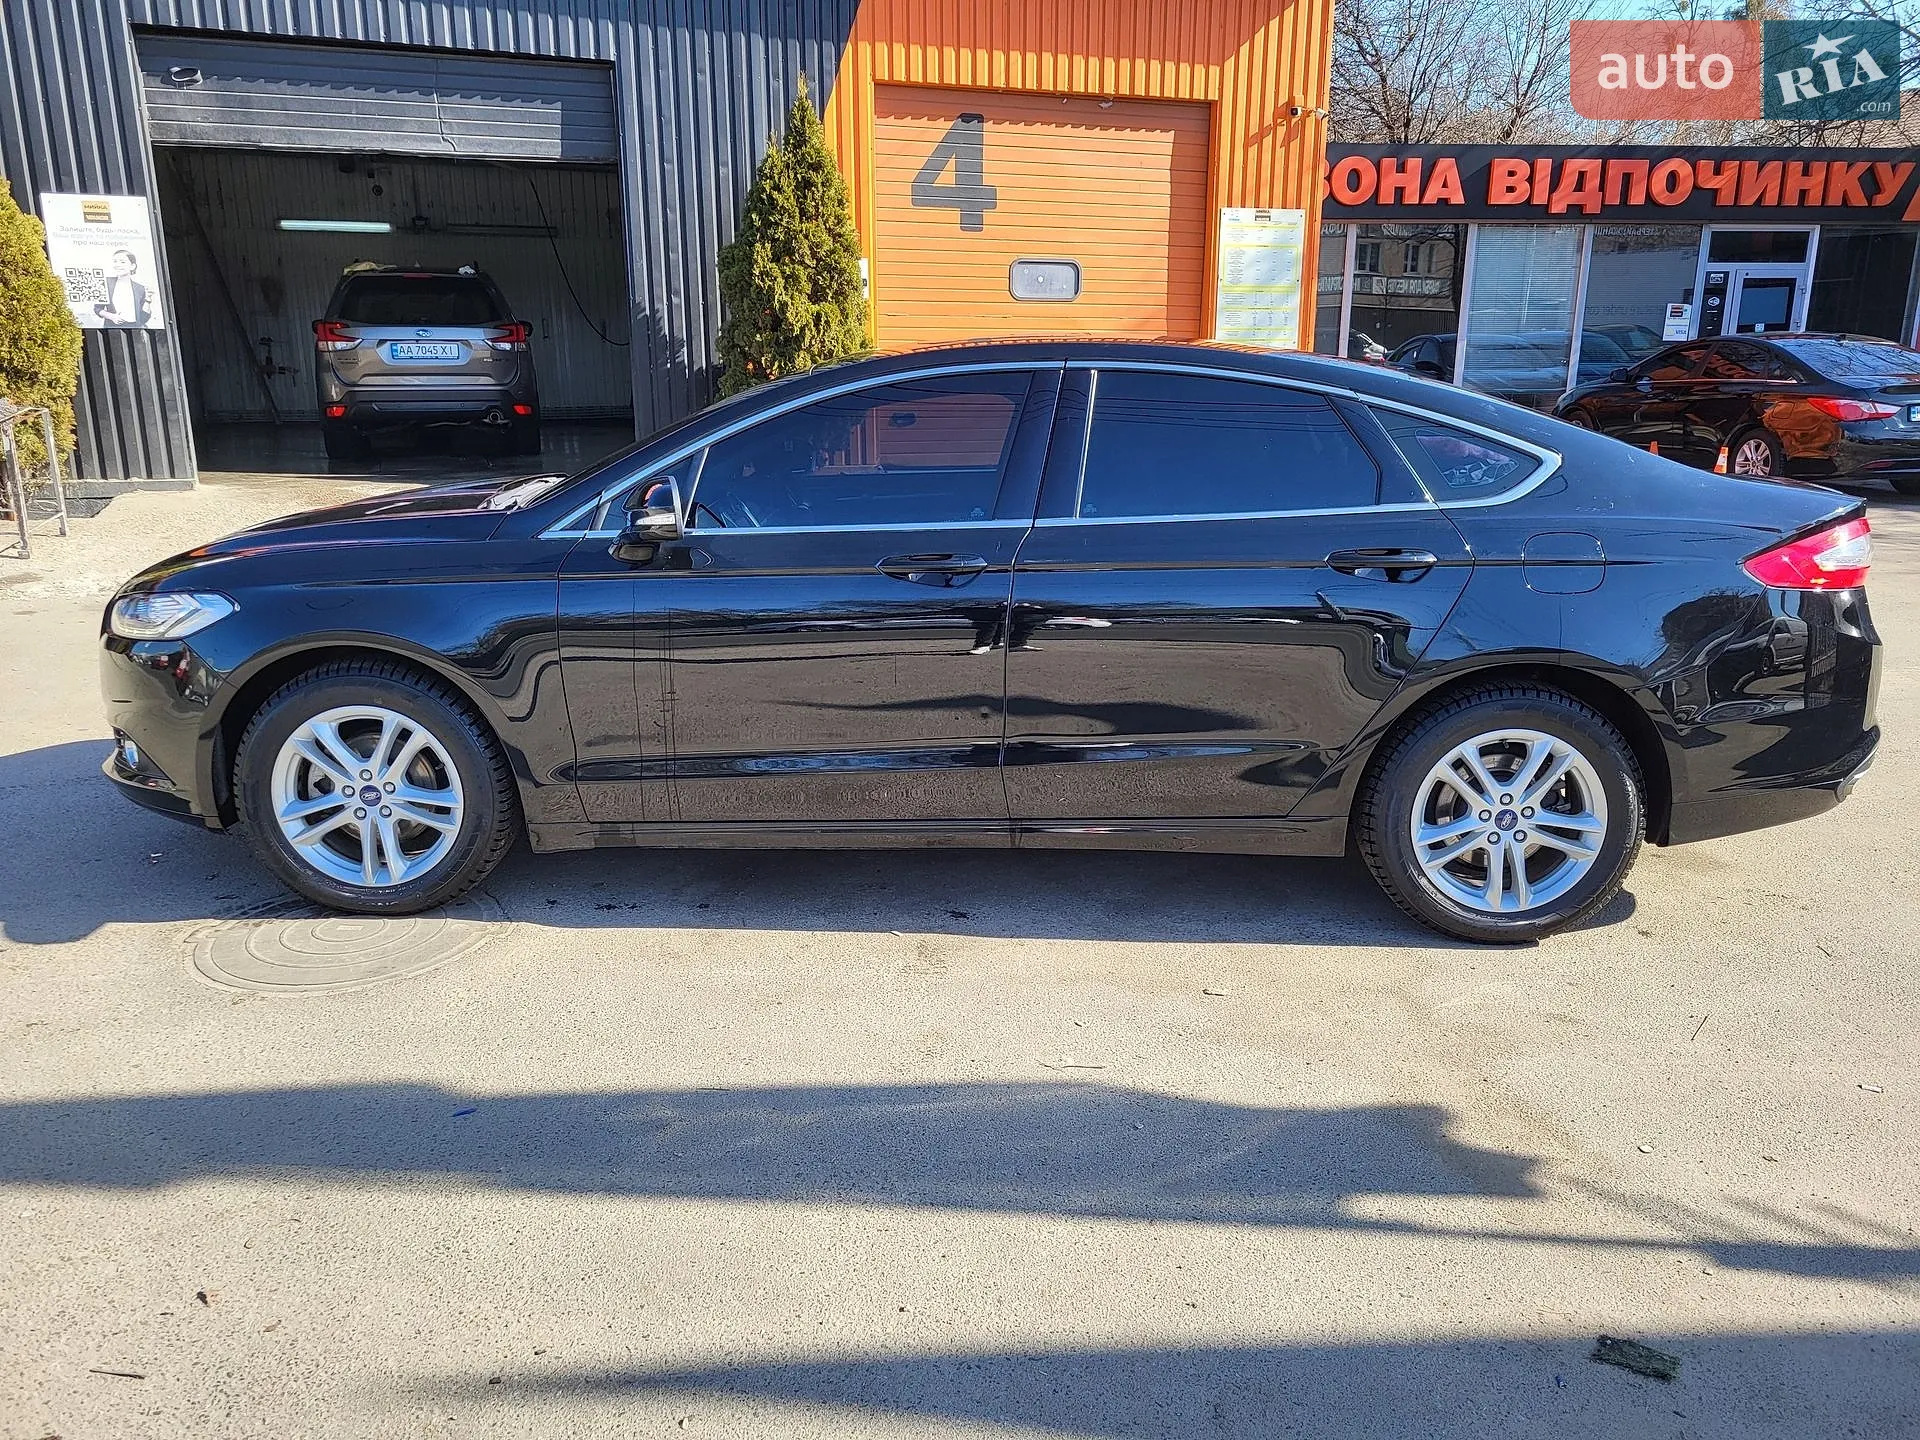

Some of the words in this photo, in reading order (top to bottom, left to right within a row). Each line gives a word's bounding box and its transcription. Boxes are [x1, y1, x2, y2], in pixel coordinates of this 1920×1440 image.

[911, 112, 998, 233] 4
[1323, 155, 1466, 206] ОНА
[1487, 157, 1917, 215] ВІДПОЧИНКУ
[399, 345, 413, 356] AA
[415, 345, 439, 356] 7045
